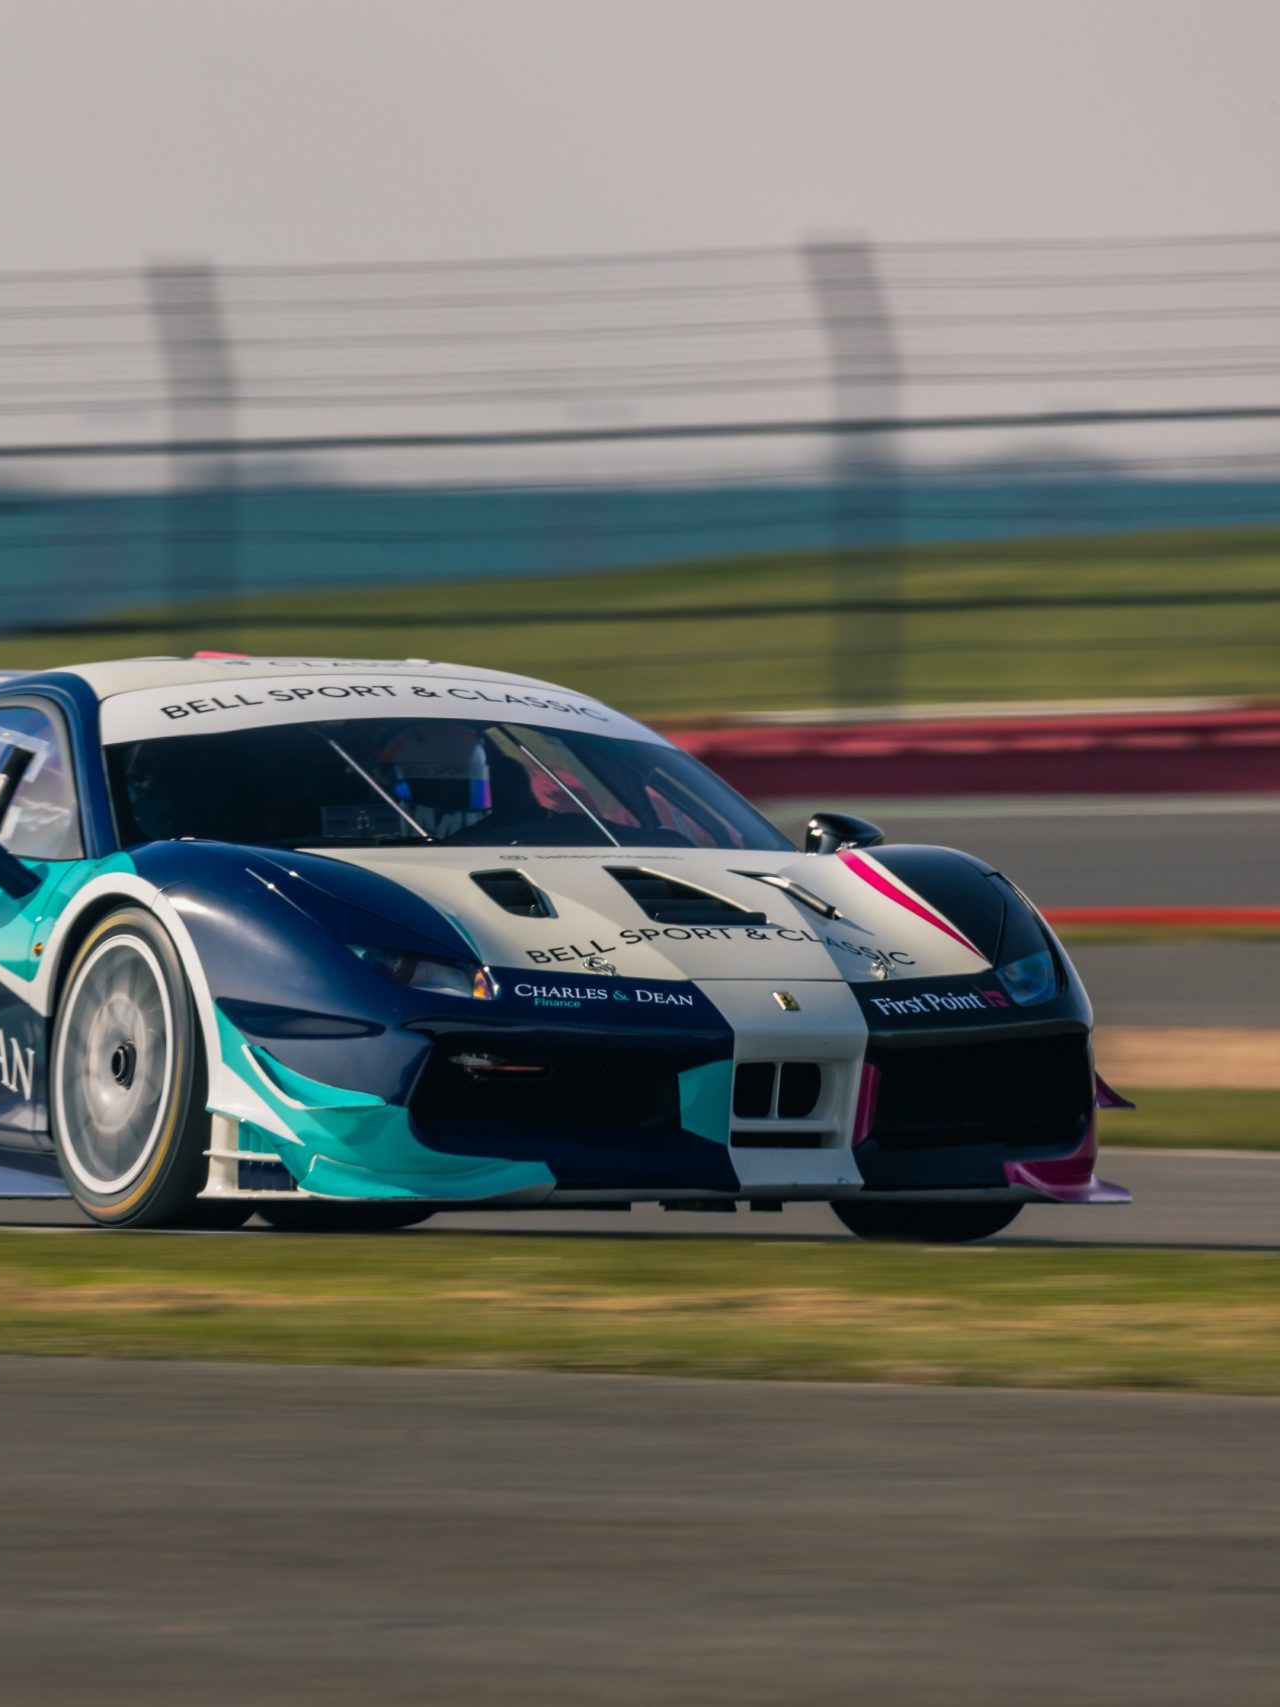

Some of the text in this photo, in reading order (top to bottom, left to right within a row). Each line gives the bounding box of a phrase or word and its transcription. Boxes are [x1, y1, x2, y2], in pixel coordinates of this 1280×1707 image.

[160, 685, 609, 722] BELL SPORT & CLASSIC
[526, 928, 916, 966] BELL SPORT & CLASSIC
[514, 983, 693, 1006] CHARLES & DEAN
[534, 997, 581, 1009] Finance
[871, 991, 987, 1016] First Point
